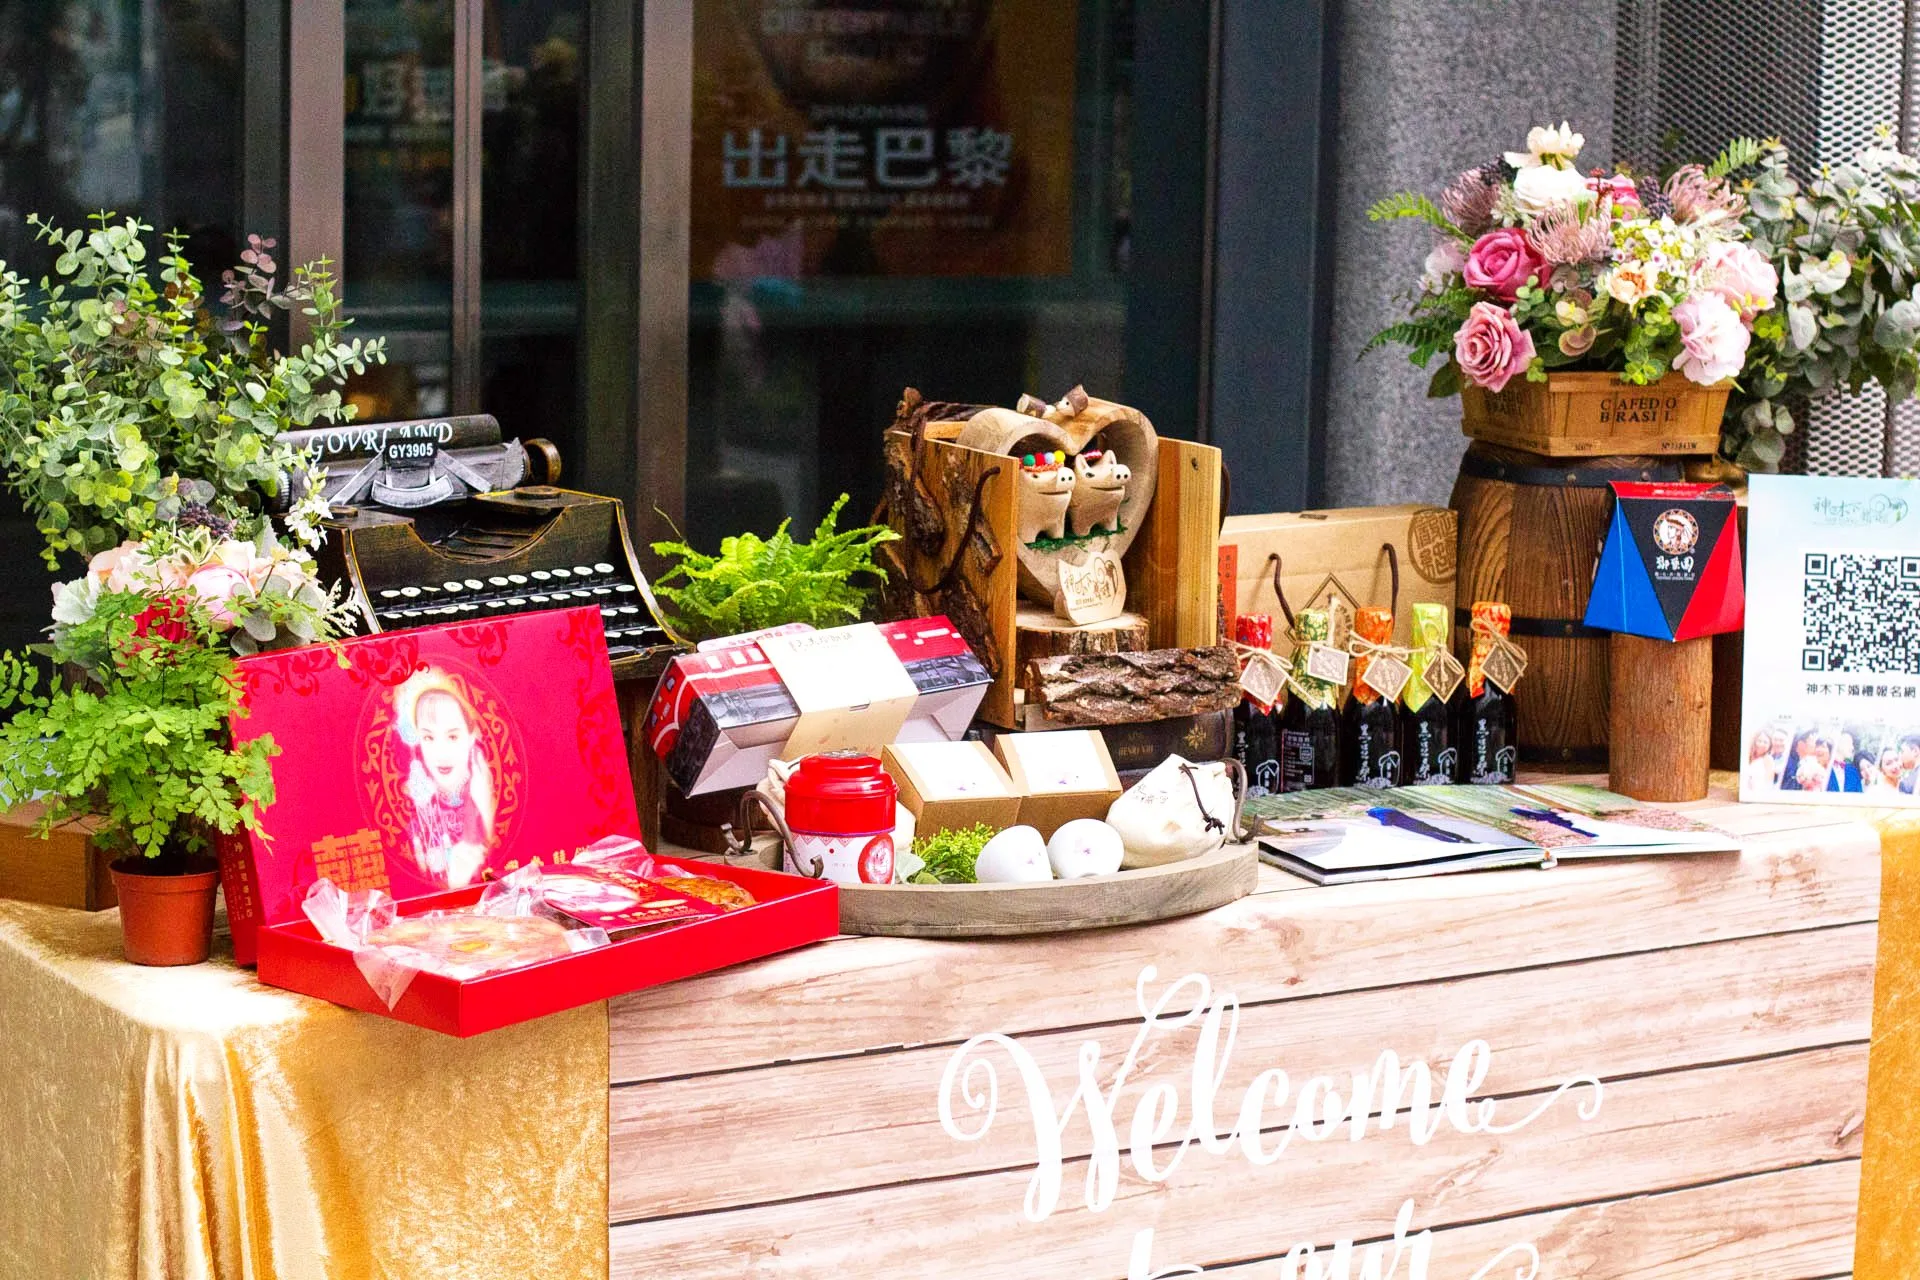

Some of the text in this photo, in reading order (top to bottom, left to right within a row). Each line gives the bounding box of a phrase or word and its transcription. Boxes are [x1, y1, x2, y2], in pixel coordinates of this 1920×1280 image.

[722, 126, 1013, 188] 出走巴黎
[388, 442, 434, 459] GY3905
[1806, 683, 1917, 698] 神木下婚禮報名網
[938, 965, 1604, 1222] Welcome
